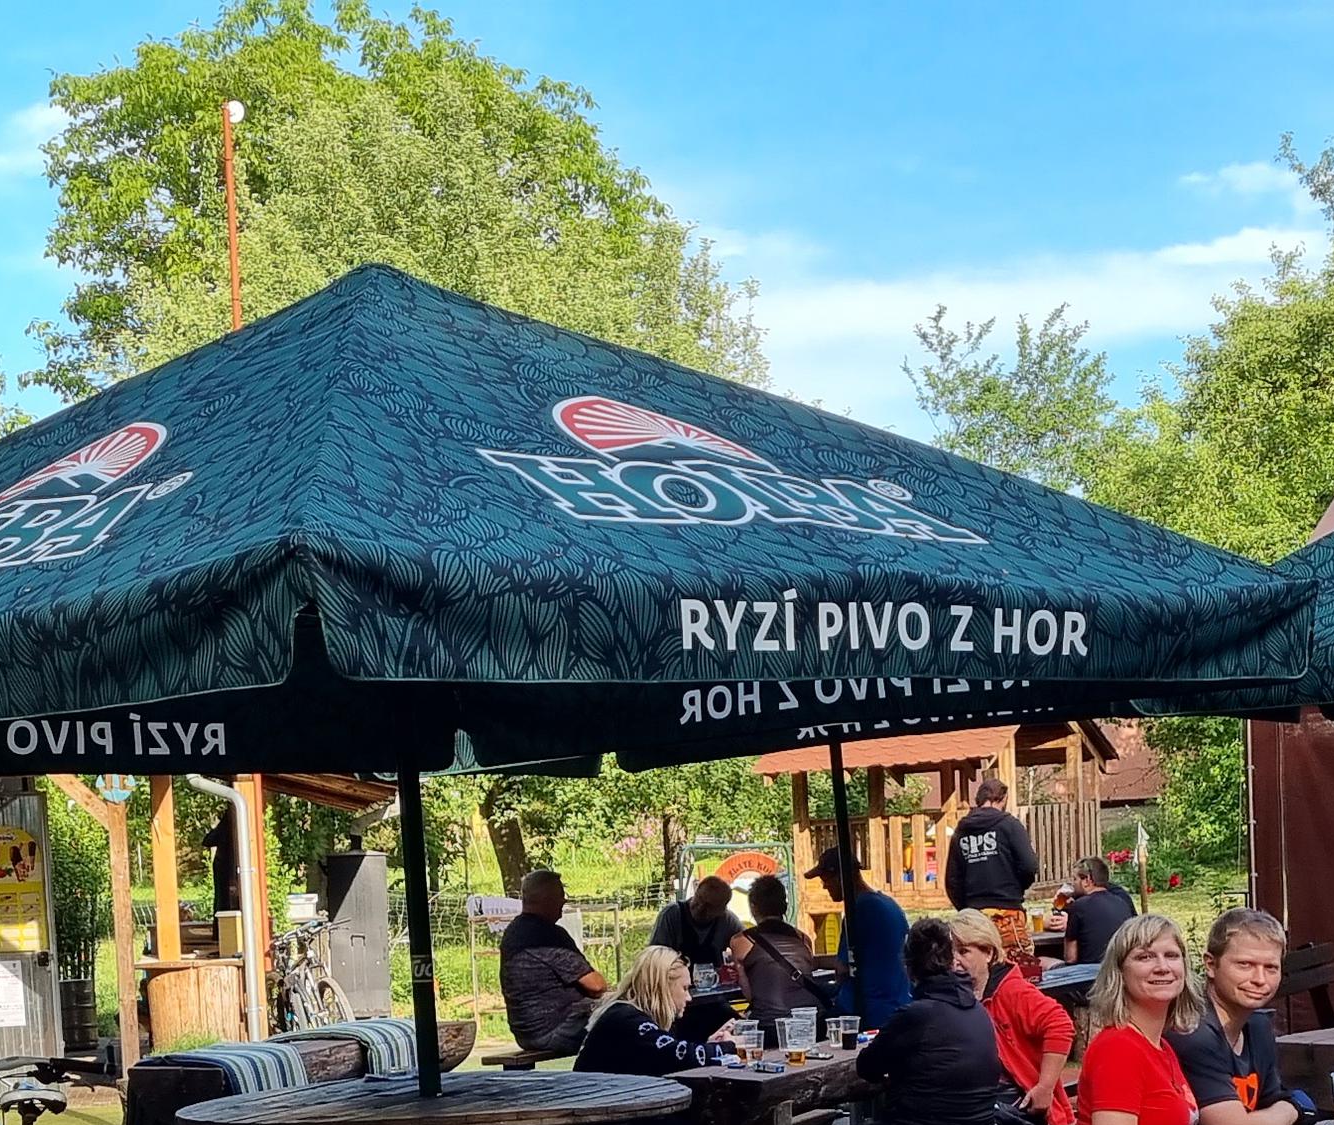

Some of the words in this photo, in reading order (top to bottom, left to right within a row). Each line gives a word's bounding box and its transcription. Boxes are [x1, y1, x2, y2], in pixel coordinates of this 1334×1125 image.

[475, 448, 989, 544] HOLBA
[679, 587, 800, 652] RYZÍ
[819, 600, 931, 651] PIVO
[950, 607, 975, 651] Z
[993, 607, 1089, 656] HOR
